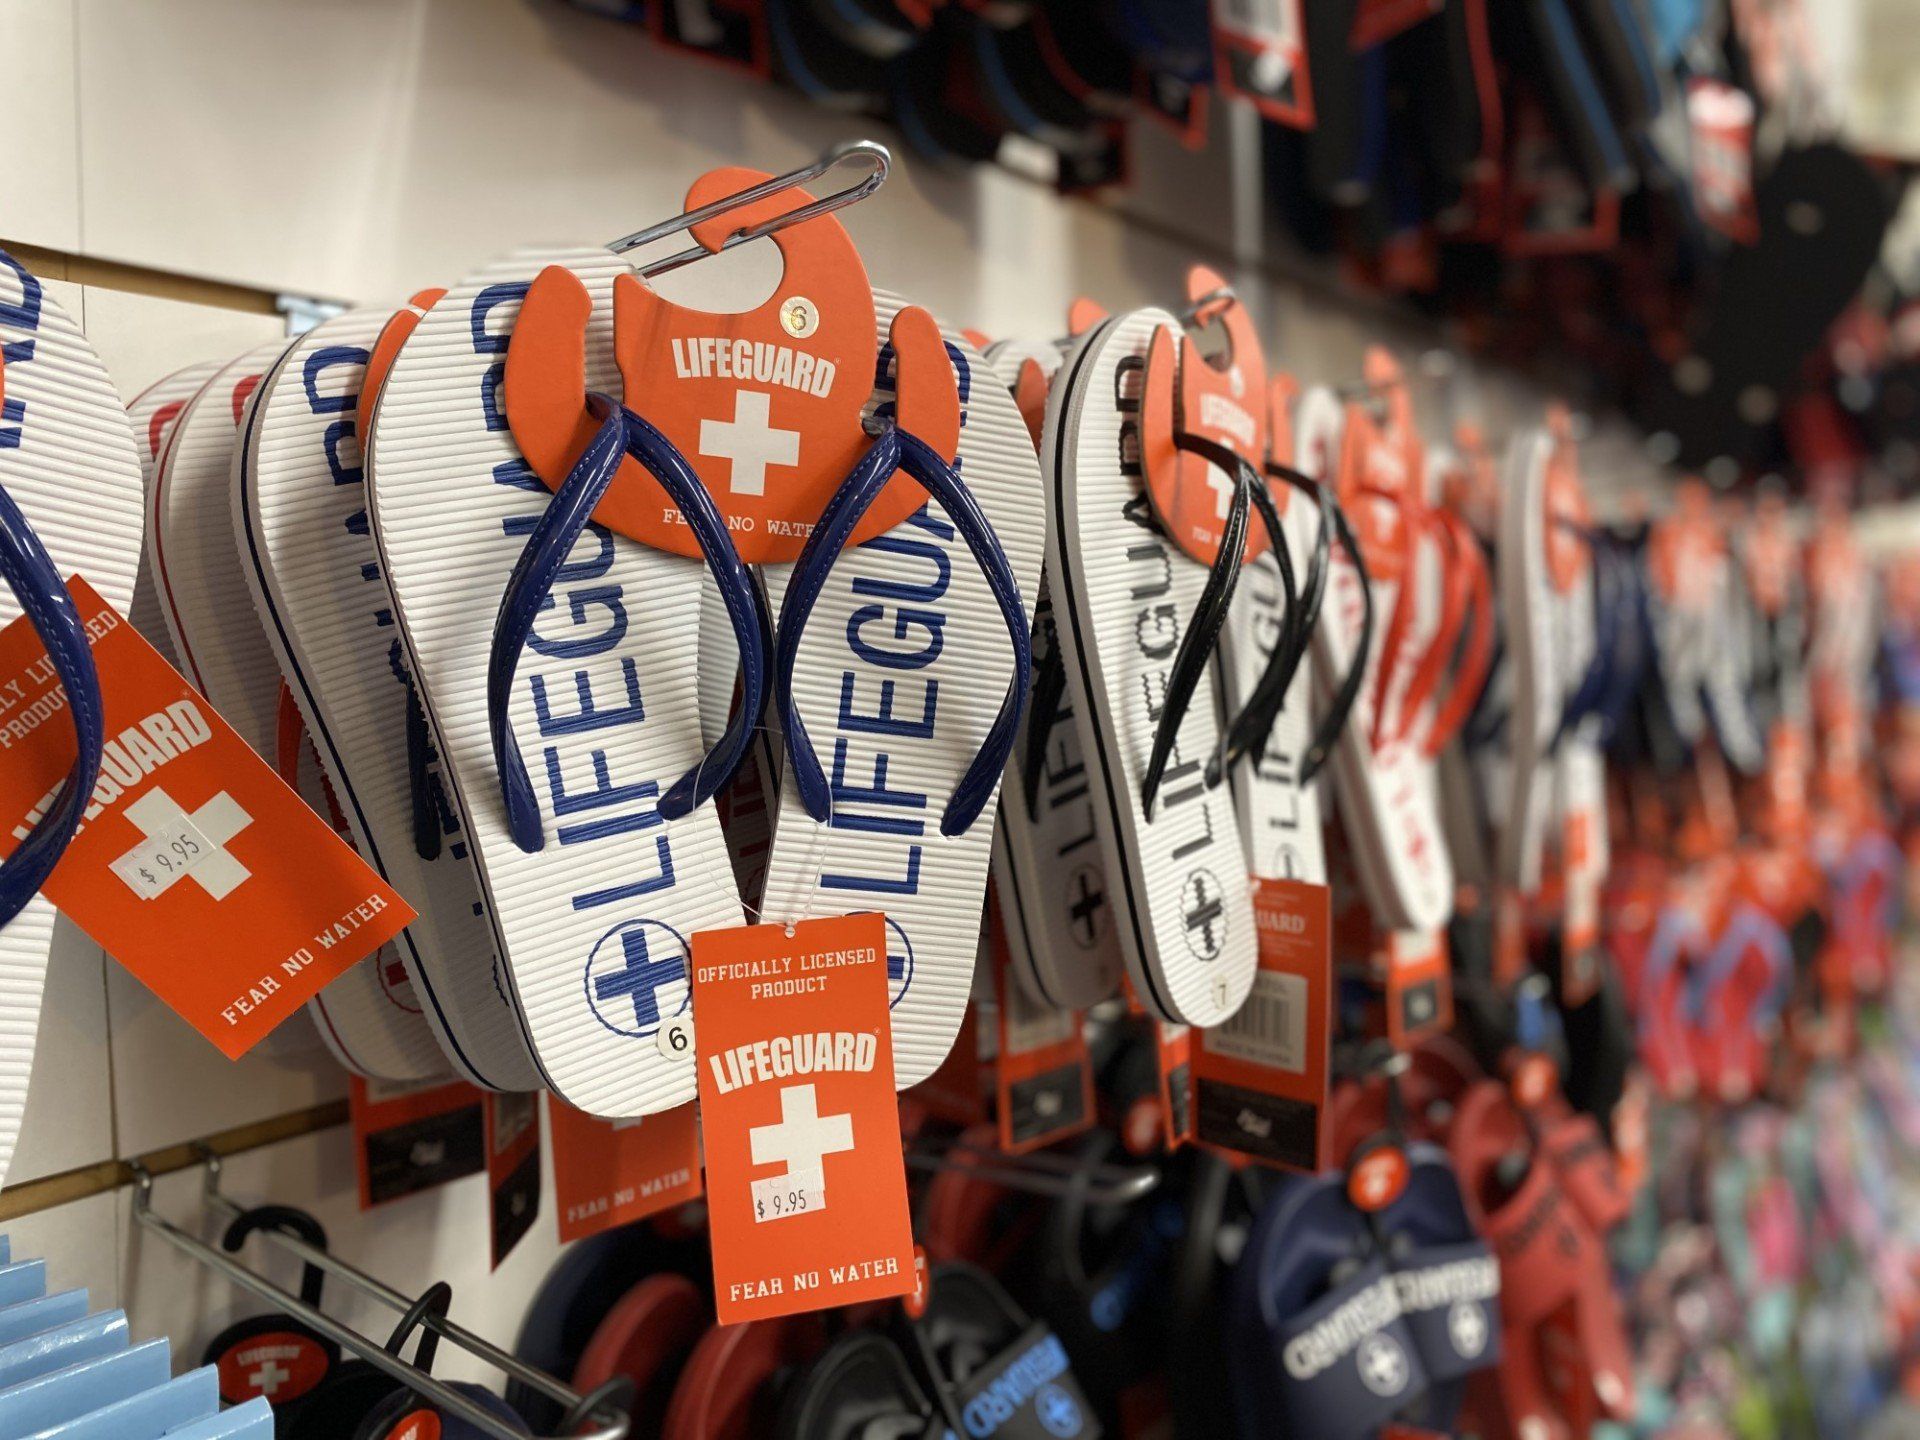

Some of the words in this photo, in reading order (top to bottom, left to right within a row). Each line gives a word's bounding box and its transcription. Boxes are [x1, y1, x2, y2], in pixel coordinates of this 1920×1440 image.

[790, 306, 807, 331] 6
[671, 337, 836, 399] LIFEGUARD
[728, 515, 755, 532] NO
[766, 519, 816, 537] WATE
[0, 683, 68, 748] PRODUC
[155, 834, 200, 872] 9.95
[220, 975, 282, 1026] FEAR
[280, 948, 314, 977] NO
[313, 893, 388, 950] WATER
[697, 956, 792, 984] OFFICIALLY
[800, 948, 876, 971] LICENSED
[751, 975, 827, 1000] PRODUCT
[669, 1026, 688, 1051] 6
[709, 1032, 877, 1095] LIFEGUARD
[567, 1197, 608, 1224] FEAR
[614, 1187, 635, 1207] NO
[640, 1167, 690, 1198] WATER
[773, 1189, 807, 1215] 9.95
[730, 1277, 784, 1302] FEAR
[793, 1271, 820, 1291] NO
[829, 1257, 899, 1285] WATER
